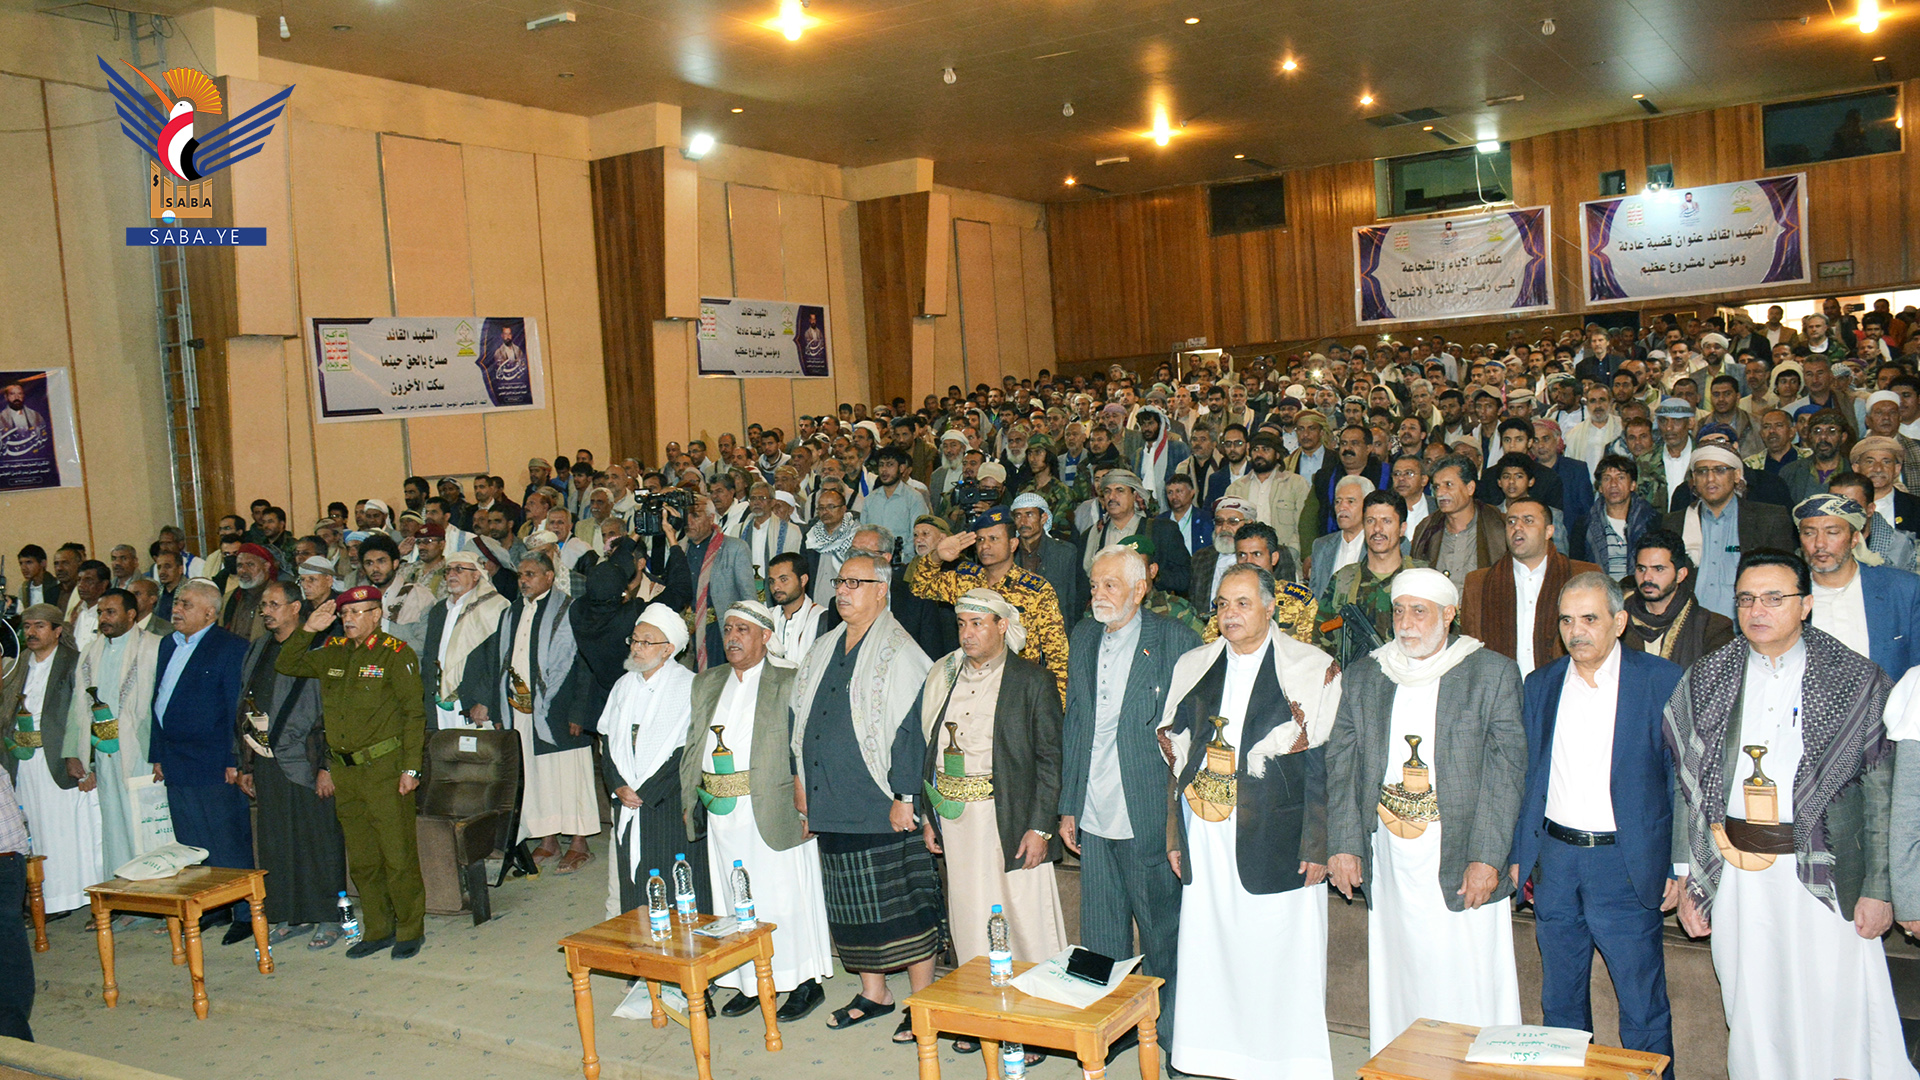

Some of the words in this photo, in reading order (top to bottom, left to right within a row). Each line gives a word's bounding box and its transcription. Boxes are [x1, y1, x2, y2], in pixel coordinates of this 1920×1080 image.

[1707, 228, 1735, 241] القائد
[1736, 225, 1768, 240] الشهيد
[1618, 241, 1645, 252] عادلة
[1646, 234, 1673, 250] قضية
[1401, 259, 1446, 274] والشجاعة
[1640, 262, 1667, 276] عظيم
[1669, 256, 1705, 274] لمشروع
[386, 328, 410, 341] القائد
[412, 327, 438, 344] الشهيد
[380, 354, 403, 370] حينما
[406, 354, 427, 370] بالحق
[428, 354, 448, 370] صدع
[427, 378, 445, 391] سكت
